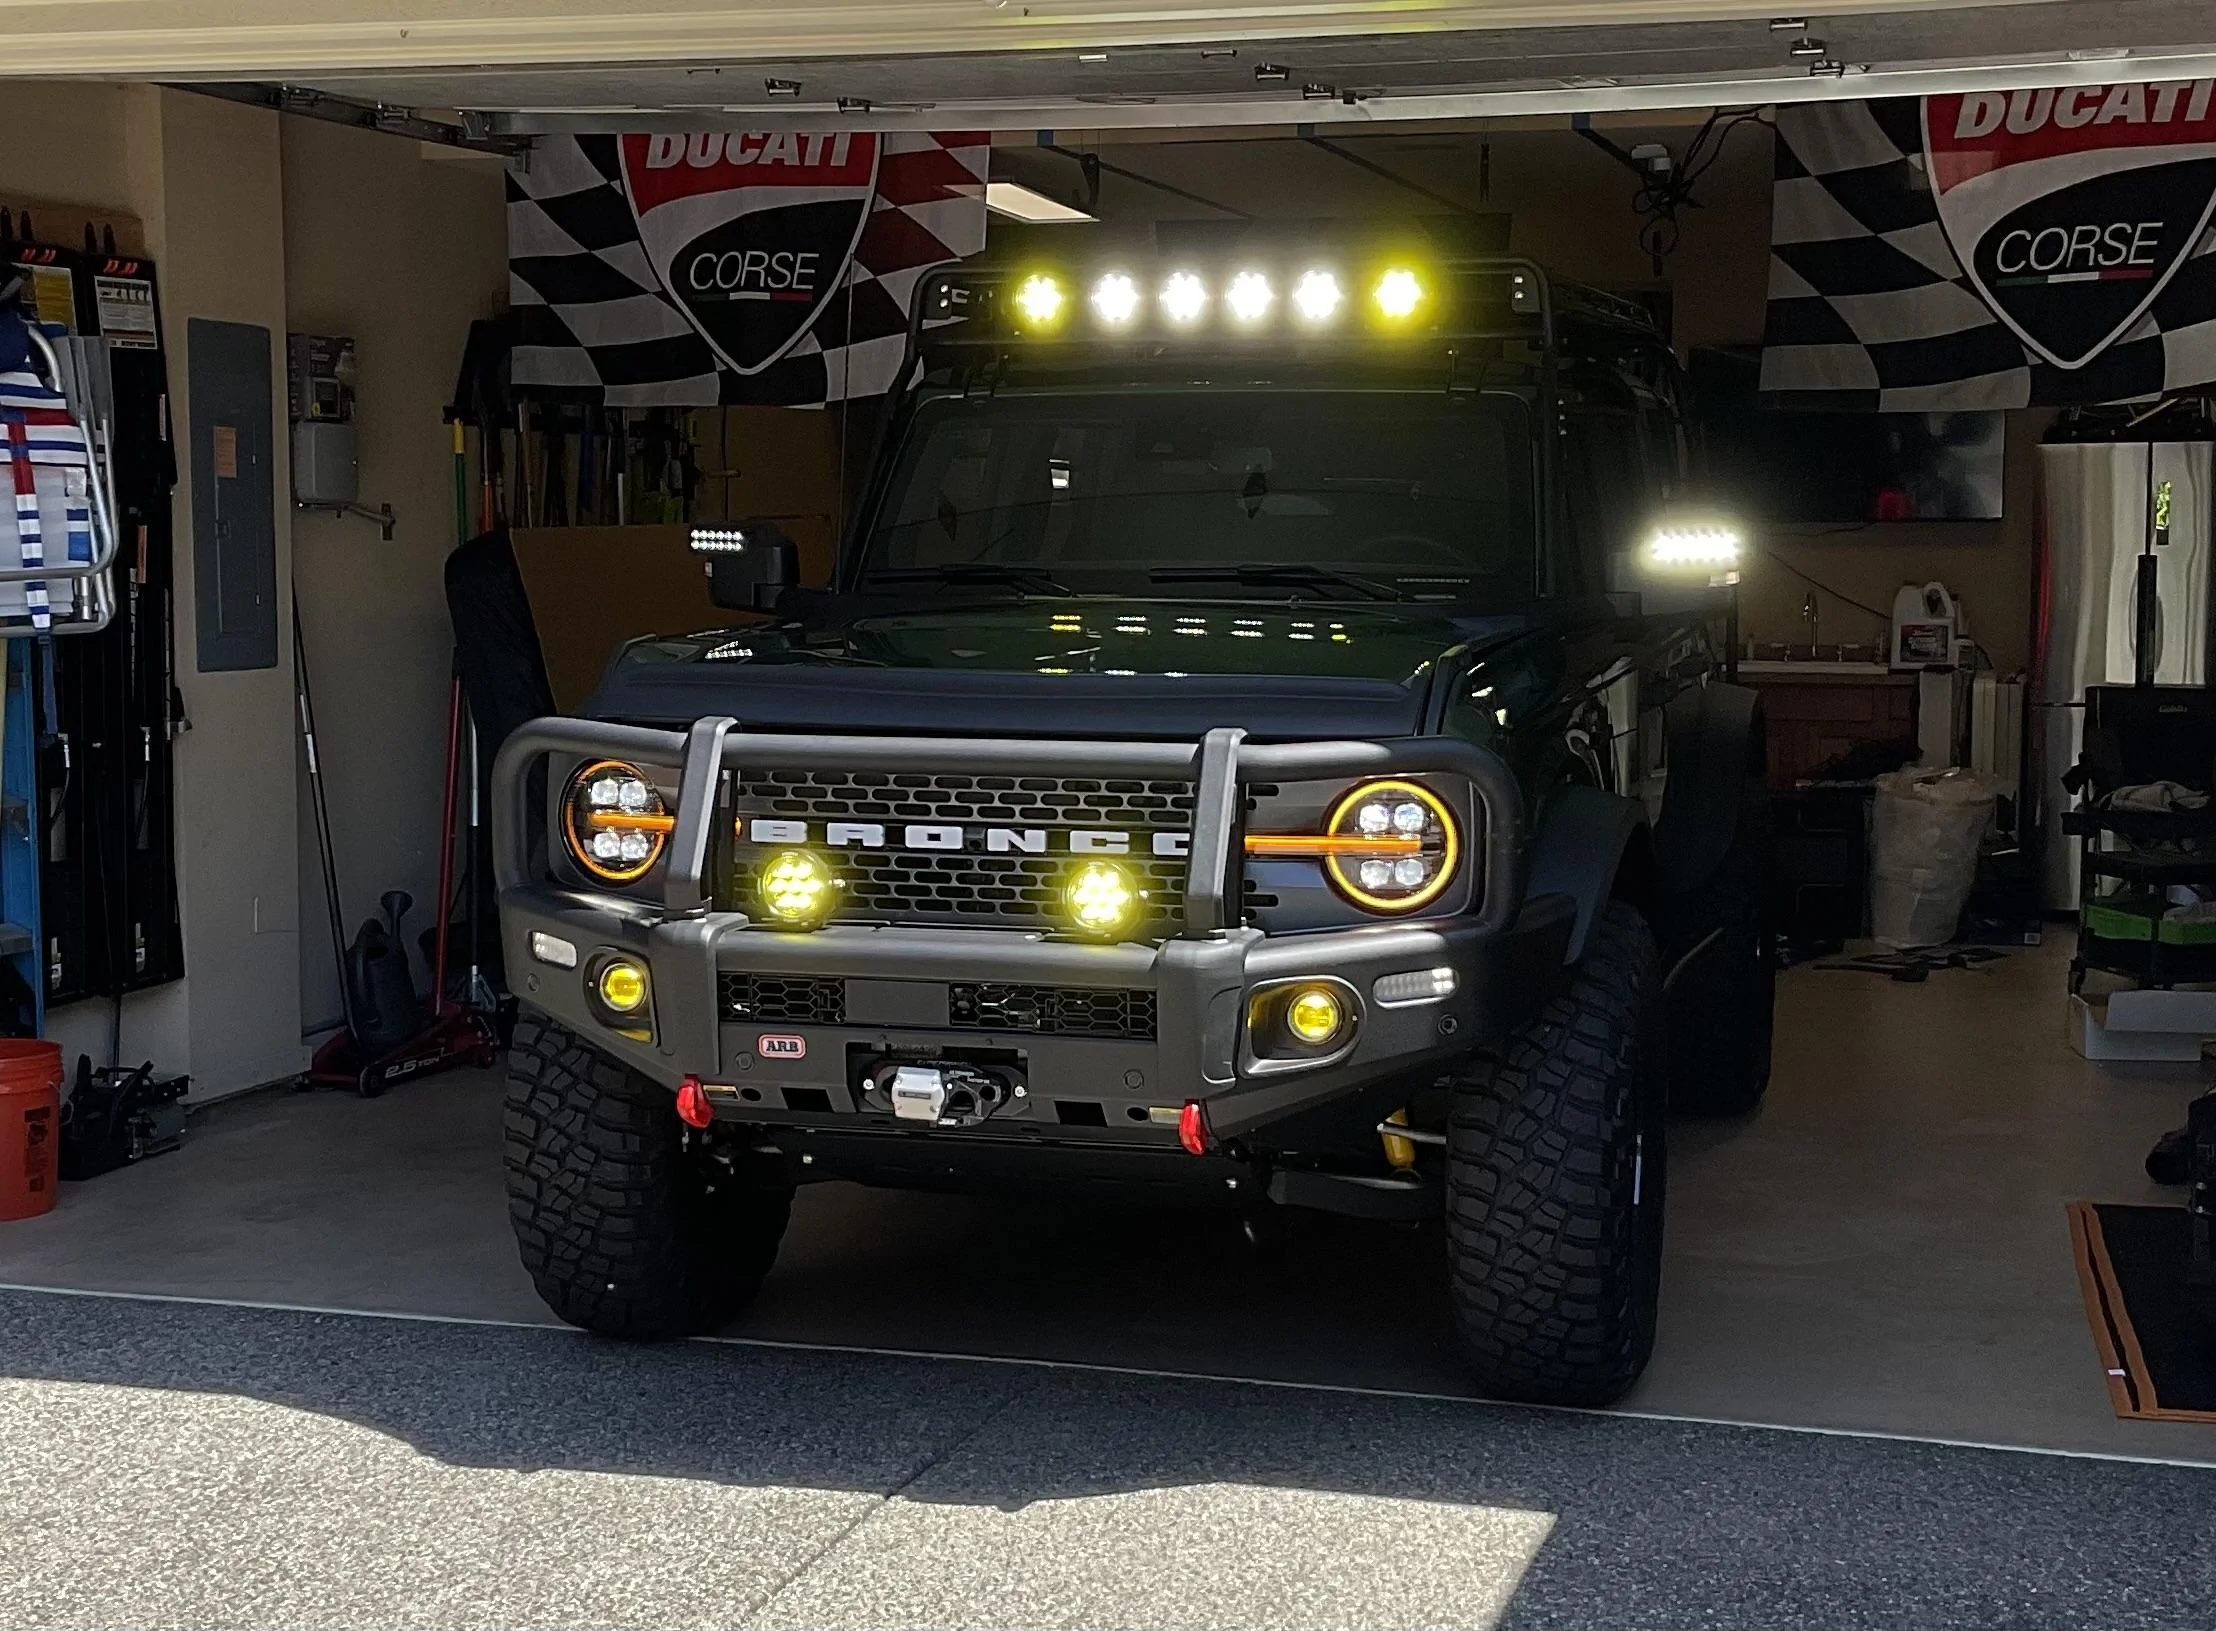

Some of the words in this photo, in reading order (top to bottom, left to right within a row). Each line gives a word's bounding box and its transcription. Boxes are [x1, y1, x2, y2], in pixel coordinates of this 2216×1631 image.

[1954, 78, 2215, 140] DUCATI
[645, 132, 851, 169] DUCATI
[1996, 221, 2164, 273] CORSE
[689, 250, 820, 291] CORSE
[765, 1040, 799, 1053] ARB
